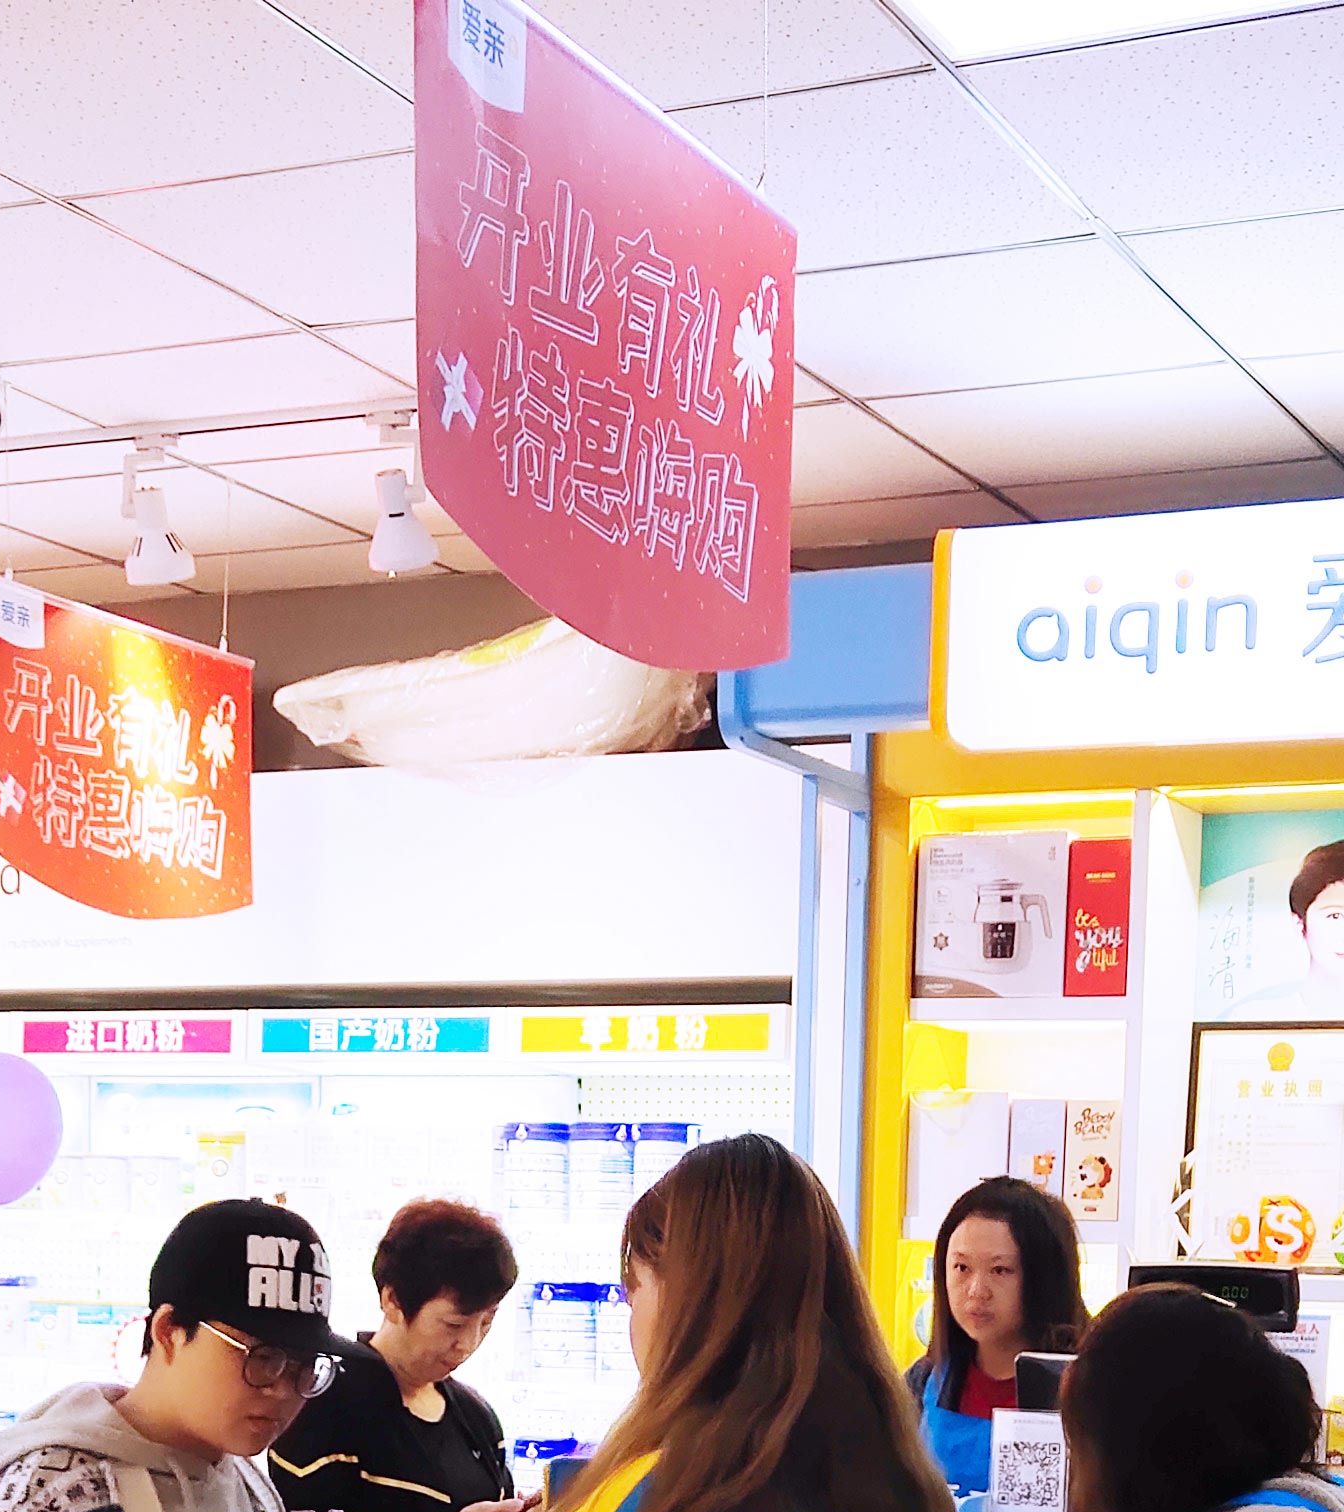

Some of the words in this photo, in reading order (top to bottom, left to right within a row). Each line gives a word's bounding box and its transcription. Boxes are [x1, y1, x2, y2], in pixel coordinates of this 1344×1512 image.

[461, 5, 505, 68] 爱亲
[458, 122, 725, 426] 开业有礼
[491, 328, 759, 604] 特惠嗨购
[0, 598, 32, 630] 爱亲
[1015, 574, 1259, 676] aiqin
[4, 656, 199, 786] 开业有礼
[30, 755, 227, 880] 特惠嗨购
[65, 1019, 186, 1053] 进口奶粉
[308, 1017, 440, 1052] 国产奶粉
[579, 1015, 708, 1051] 羊奶粉
[1236, 1079, 1324, 1099] 营业执照
[246, 1233, 301, 1269] MY
